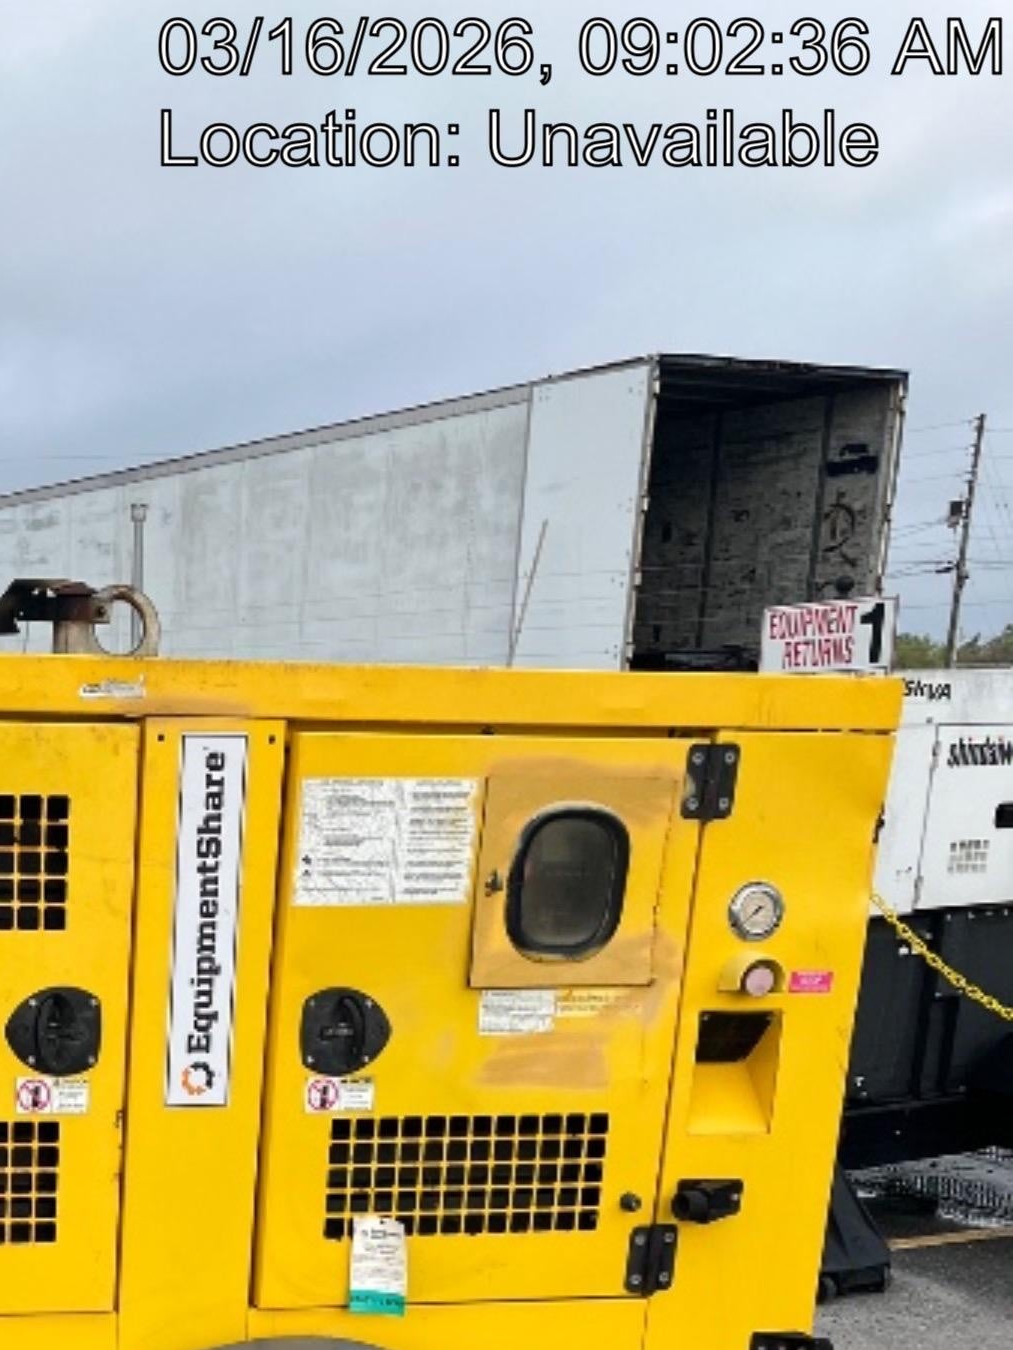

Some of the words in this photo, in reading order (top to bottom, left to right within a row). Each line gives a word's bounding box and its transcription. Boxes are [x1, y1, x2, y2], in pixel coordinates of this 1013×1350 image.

[769, 605, 857, 640] EQUIPMENT
[860, 602, 885, 663] 1
[781, 635, 855, 669] RETURNS
[186, 749, 227, 1055] EquipmentShare
